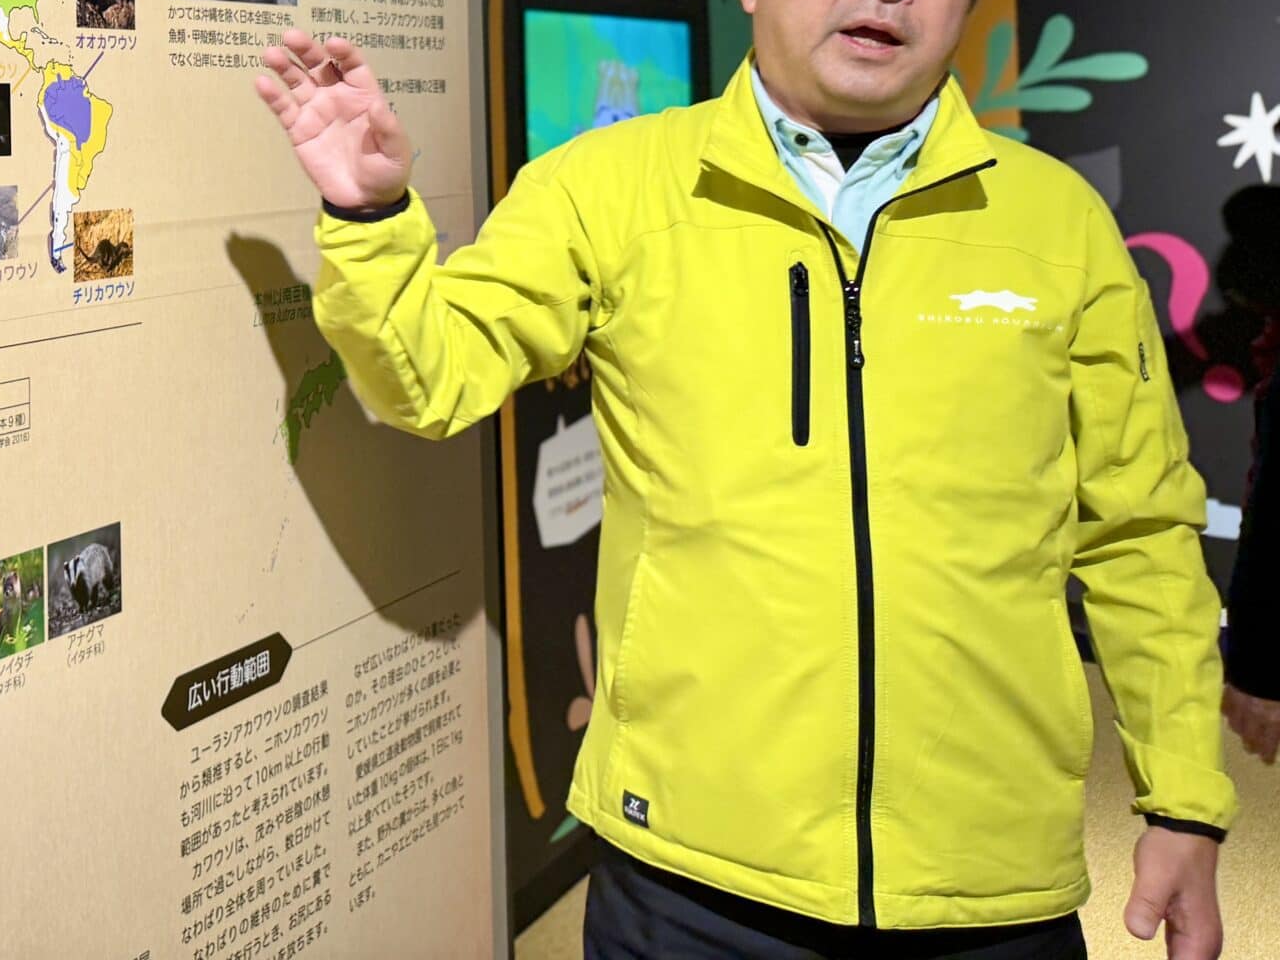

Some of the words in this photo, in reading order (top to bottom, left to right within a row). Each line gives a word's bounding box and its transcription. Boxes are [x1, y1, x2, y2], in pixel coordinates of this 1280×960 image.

[76, 34, 137, 51] オオカワウソ
[73, 281, 135, 304] チリカワウソ
[67, 624, 105, 650] アナグマ
[67, 640, 105, 668] （イタチ科）
[187, 650, 271, 712] 広い行動範囲
[191, 680, 329, 763] ユーラシアカワウソの調査結果
[180, 707, 329, 800] から類推すると、ニホンカワウソ
[180, 762, 328, 857] 範囲があったと考えられています。
[181, 810, 331, 915] 場所で過ごしながら、数日かけて
